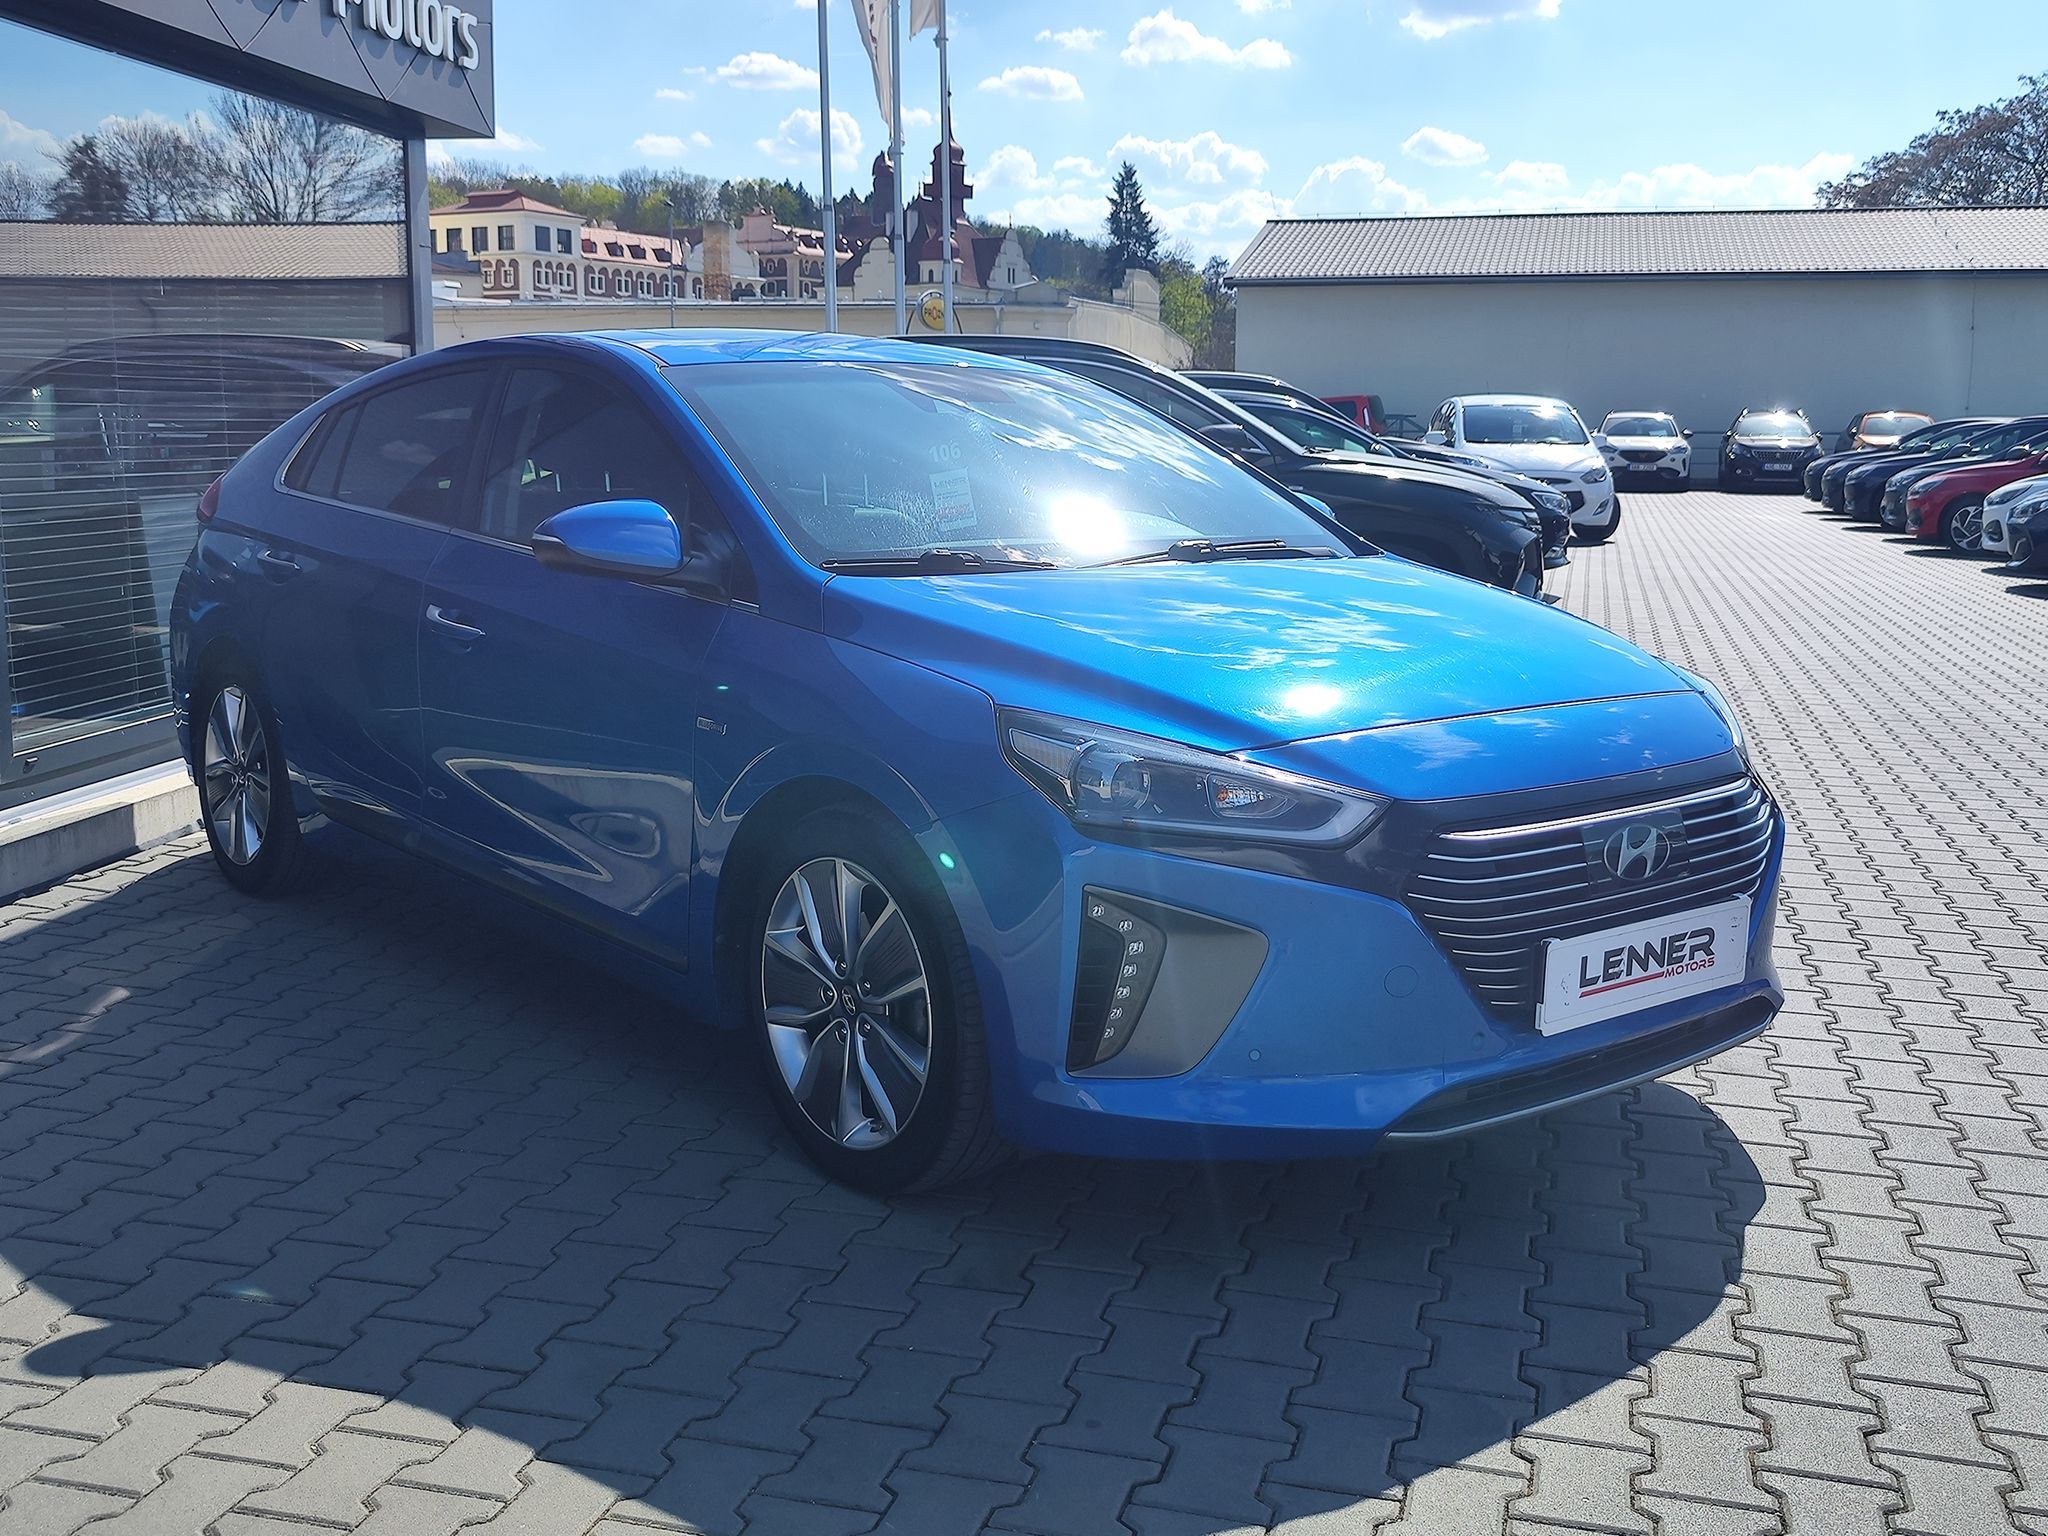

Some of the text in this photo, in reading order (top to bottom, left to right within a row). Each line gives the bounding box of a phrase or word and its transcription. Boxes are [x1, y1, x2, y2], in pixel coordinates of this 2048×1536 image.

[929, 443, 962, 463] 106
[1579, 926, 1716, 989] LENNER
[1663, 956, 1716, 979] MOTORS
